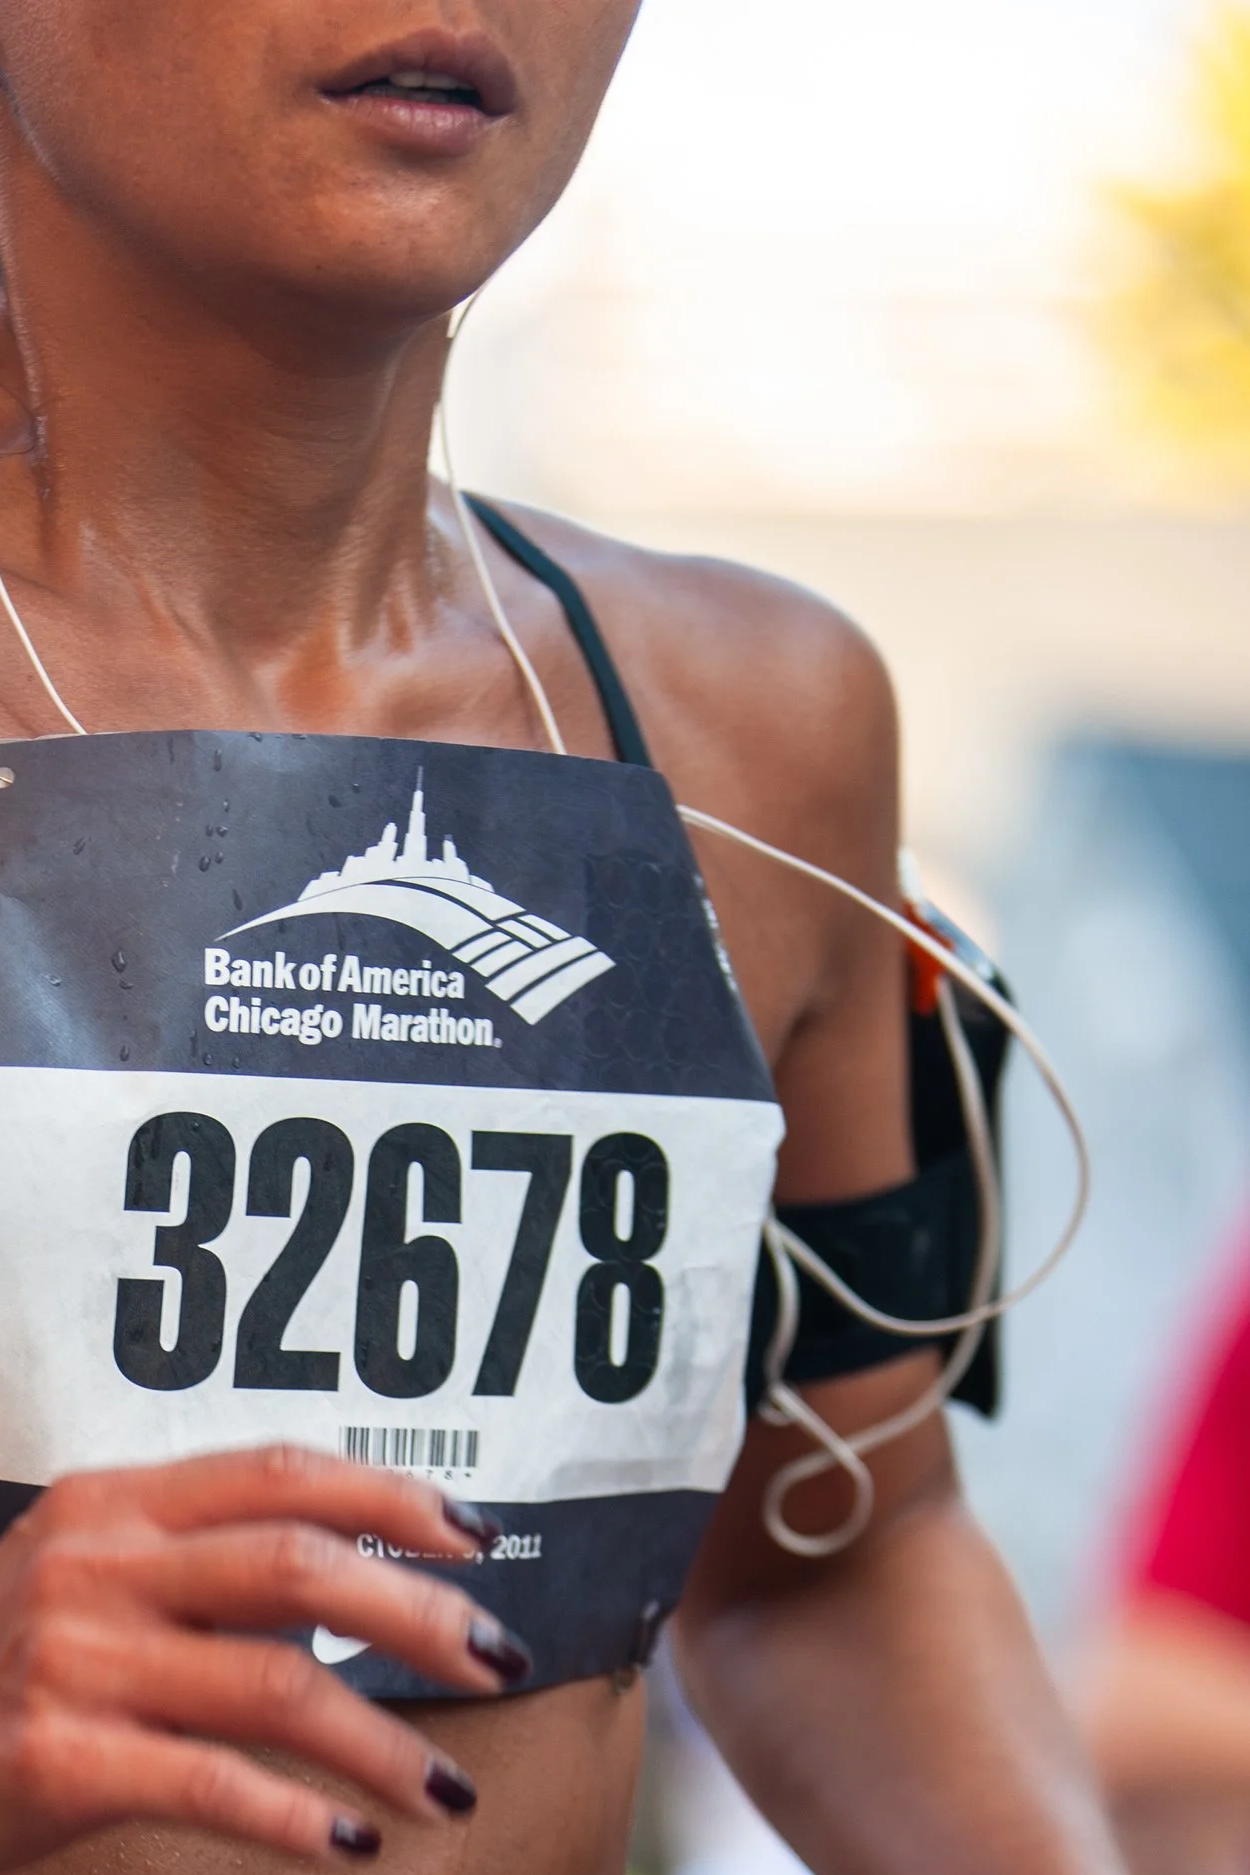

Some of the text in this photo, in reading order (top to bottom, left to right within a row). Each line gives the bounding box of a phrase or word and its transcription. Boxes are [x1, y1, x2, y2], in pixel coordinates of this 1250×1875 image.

[205, 948, 465, 999] Bank of America
[205, 995, 343, 1046] Chicago
[113, 1111, 669, 1404] 32678
[490, 1533, 541, 1560] 2011
